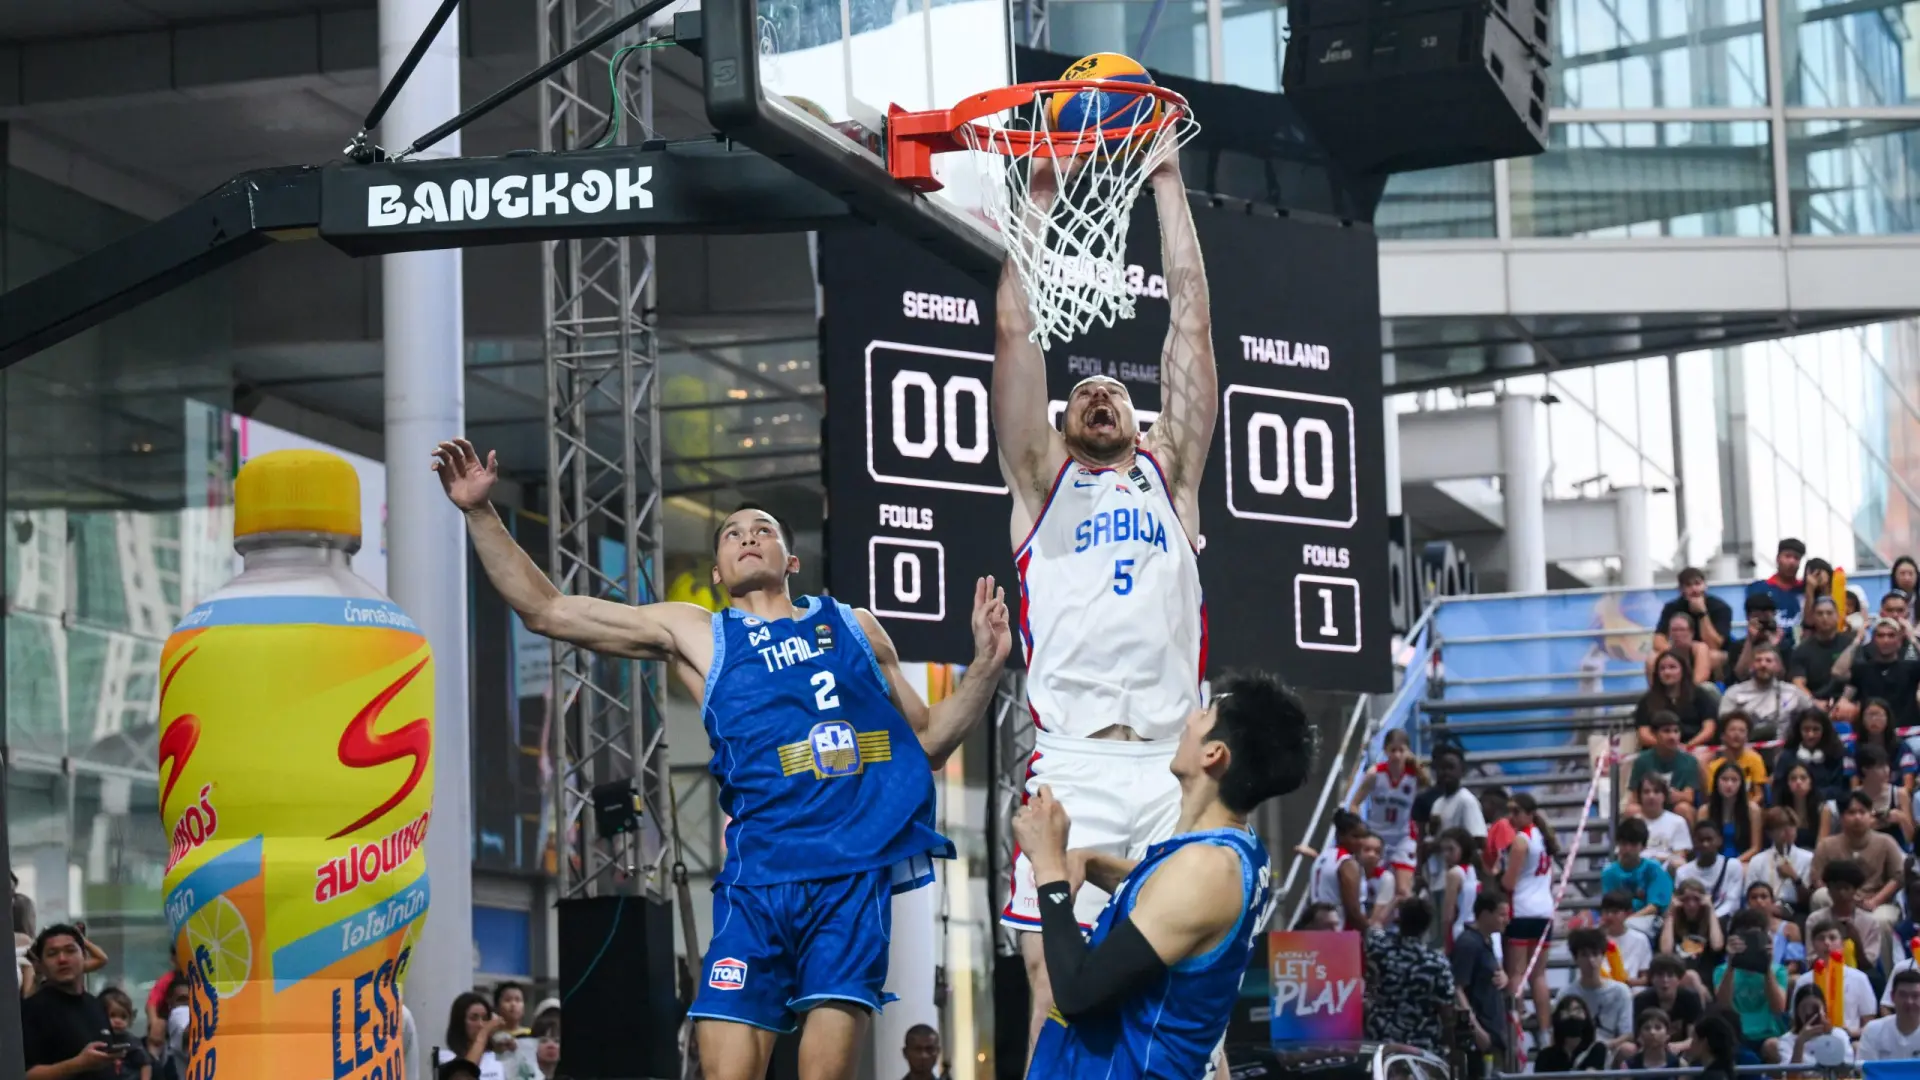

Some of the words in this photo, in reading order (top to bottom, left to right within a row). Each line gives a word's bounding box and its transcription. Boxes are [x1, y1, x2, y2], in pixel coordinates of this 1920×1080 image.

[367, 165, 654, 228] BANGKOK
[902, 290, 980, 326] SERBIA
[1068, 355, 1103, 376] POOL
[1108, 361, 1118, 379] A
[1119, 362, 1161, 384] GAME
[1239, 334, 1331, 371] THAILAND
[891, 369, 990, 464] 00
[1247, 411, 1335, 500] 00
[879, 503, 934, 531] FOULS
[1074, 507, 1169, 554] SRBIJA
[1302, 543, 1351, 569] FOULS
[893, 551, 922, 604] 0
[1113, 558, 1136, 596] 5
[1317, 588, 1340, 637] 1
[809, 670, 841, 711] 2
[714, 967, 742, 982] TOA
[1273, 978, 1359, 1018] PLAY
